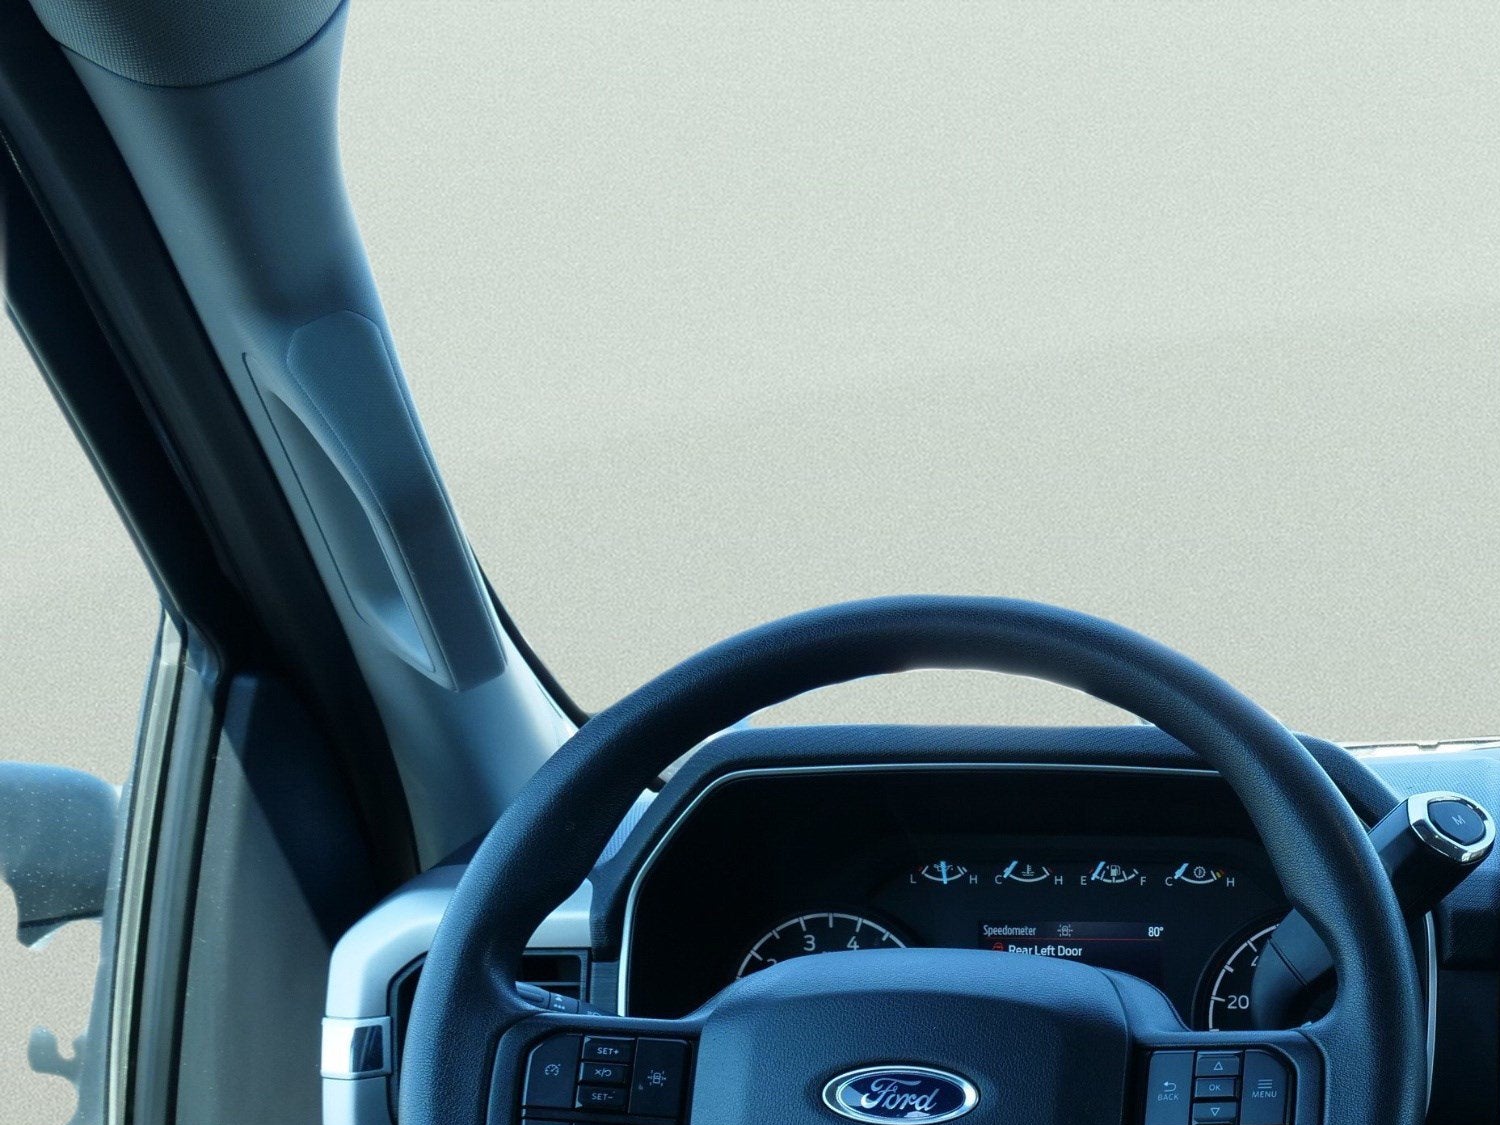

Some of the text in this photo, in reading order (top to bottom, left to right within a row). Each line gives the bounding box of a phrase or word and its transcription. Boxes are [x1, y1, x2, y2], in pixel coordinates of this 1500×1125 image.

[910, 874, 917, 885] L
[969, 875, 978, 885] H
[995, 875, 1002, 886] C
[1055, 875, 1063, 886] H
[1081, 875, 1087, 886] E
[1140, 875, 1147, 886] F
[1165, 876, 1173, 887] C
[1226, 877, 1235, 888] H
[983, 924, 1037, 938] Speedometer
[803, 934, 816, 951] 3
[846, 936, 860, 951] 4
[1008, 944, 1083, 957] Rear Left Door
[1227, 994, 1250, 1010] 20
[1208, 1084, 1221, 1092] OK
[861, 1077, 939, 1112] Ford
[1157, 1093, 1179, 1101] BACK
[1252, 1090, 1278, 1098] MENU
